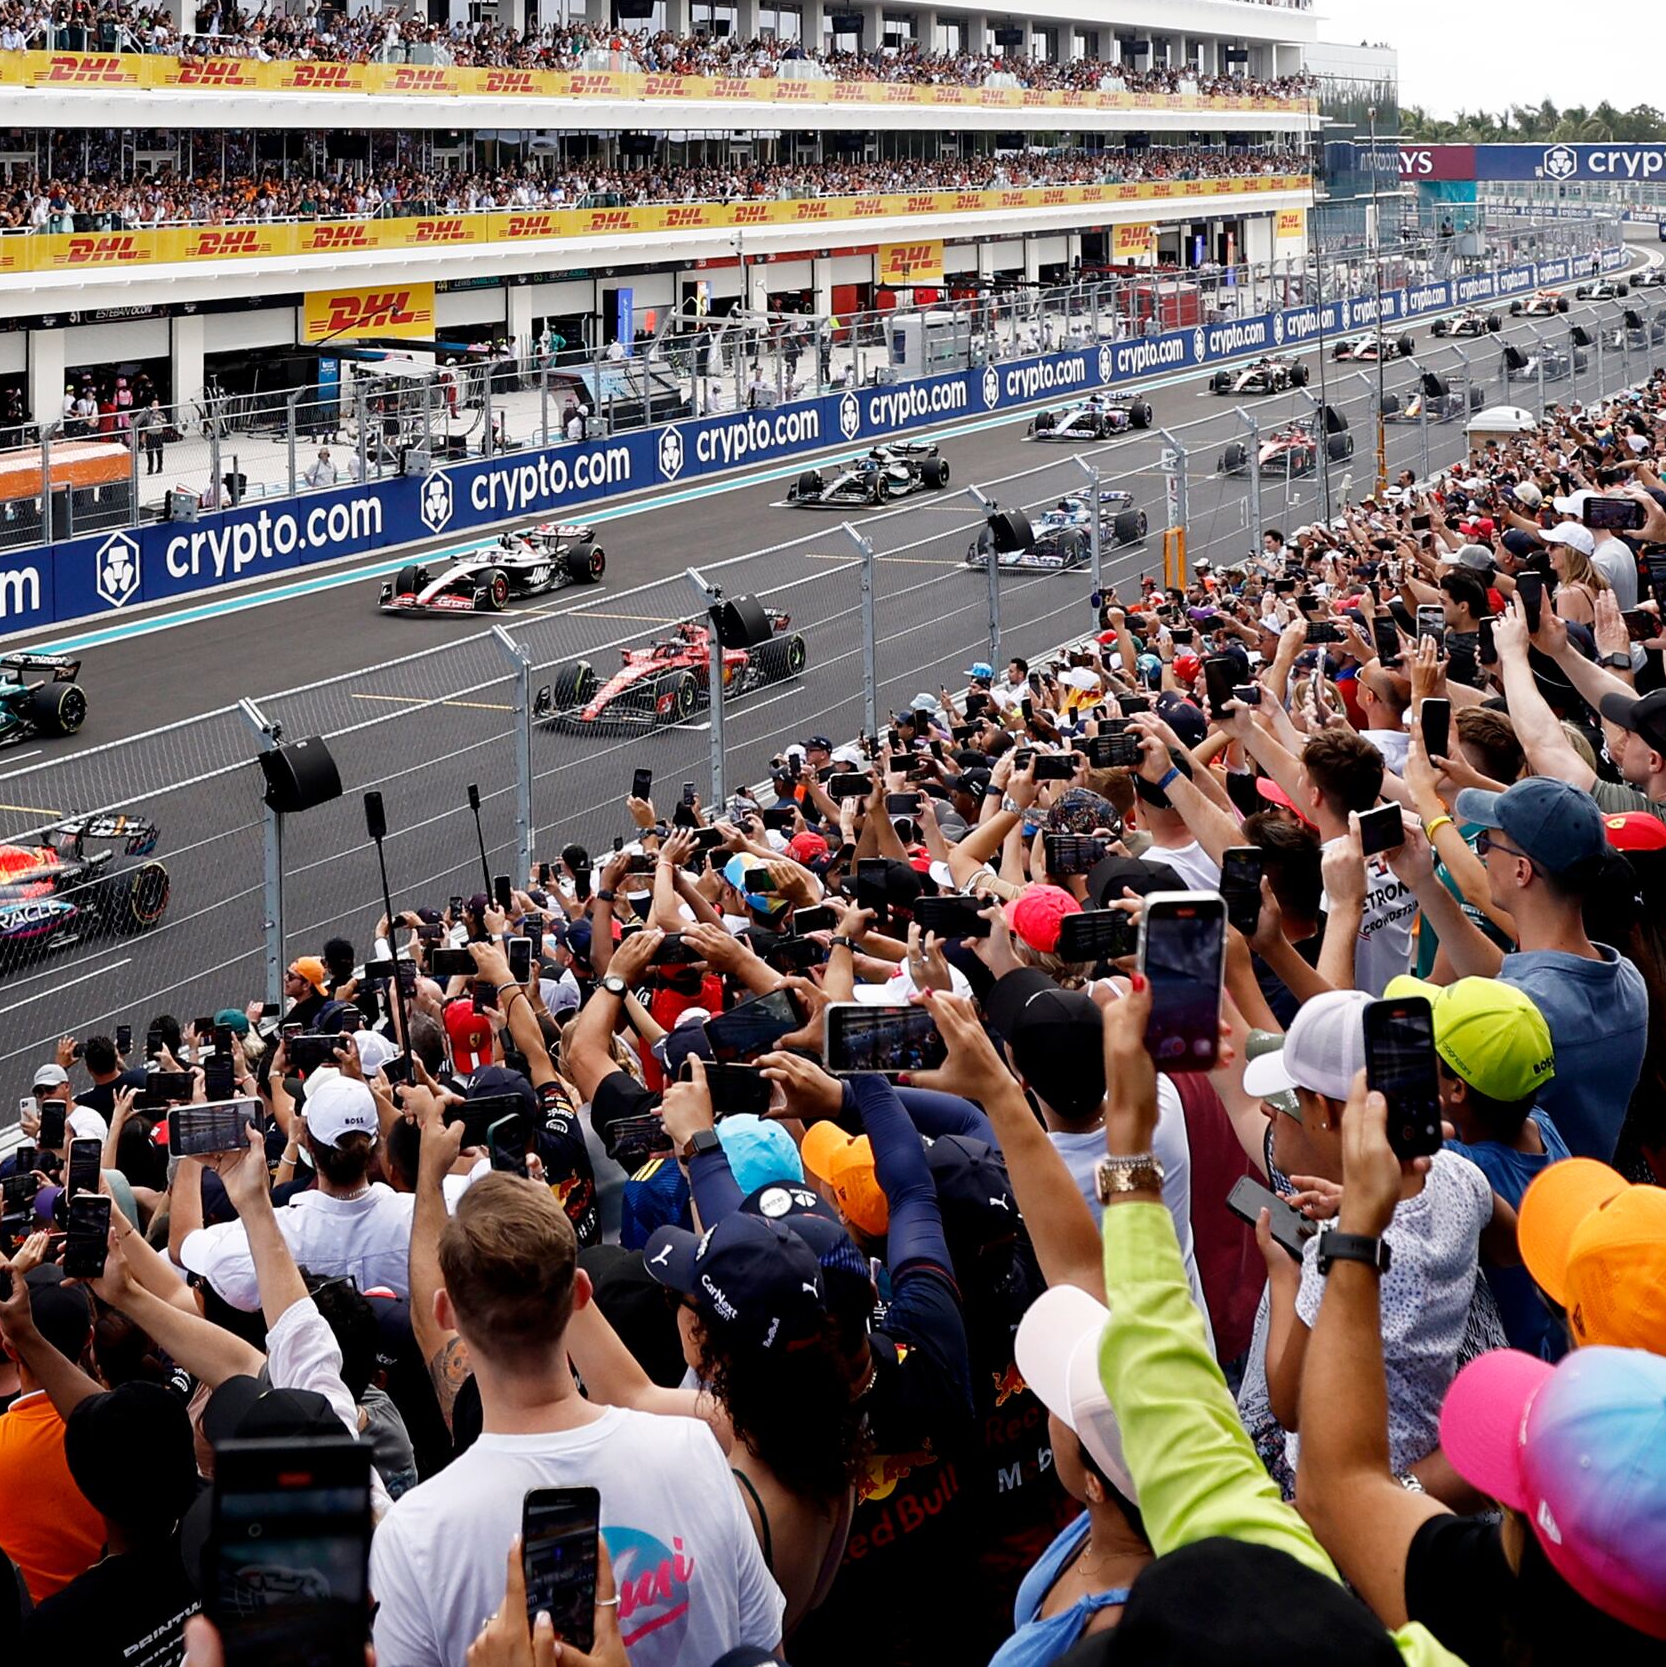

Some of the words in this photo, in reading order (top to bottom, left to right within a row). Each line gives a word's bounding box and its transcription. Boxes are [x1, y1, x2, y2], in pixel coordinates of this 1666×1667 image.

[49, 57, 125, 81] DHL
[178, 62, 245, 85] DHL
[292, 66, 351, 87] DHL
[395, 69, 448, 90] DHL
[486, 73, 534, 93] DHL
[568, 76, 615, 94] DHL
[644, 77, 685, 95] DHL
[712, 80, 749, 97] DHL
[776, 82, 809, 98] DHL
[834, 84, 863, 101] DHL
[887, 86, 916, 102] DHL
[935, 87, 962, 103] DHL
[981, 89, 1006, 104] DHL
[854, 200, 882, 214] DHL
[908, 197, 933, 212] DHL
[957, 195, 981, 208] DHL
[1002, 193, 1024, 206] DHL
[590, 211, 632, 231] DHL
[665, 208, 703, 225] DHL
[735, 206, 768, 222] DHL
[797, 203, 828, 218] DHL
[314, 225, 368, 249] DHL
[415, 220, 465, 242] DHL
[508, 216, 552, 237] DHL
[1120, 226, 1150, 248] DHL
[67, 236, 137, 263] DHL
[197, 230, 261, 255] DHL
[890, 246, 935, 270] DHL
[1410, 286, 1447, 311] crypto.com
[1459, 279, 1492, 300] crypto.com
[329, 291, 417, 331] DHL
[1209, 323, 1265, 357] crypto.com
[1117, 338, 1184, 375] crypto.com
[1007, 357, 1085, 397] crypto.com
[870, 378, 967, 425] crypto.com
[696, 406, 820, 465] crypto.com
[471, 445, 631, 512] crypto.com
[167, 496, 383, 579] crypto.com
[344, 1116, 364, 1125] BOSS
[701, 1274, 738, 1320] CarNext
[844, 1504, 896, 1564] ed
[894, 1459, 961, 1534] Bull
